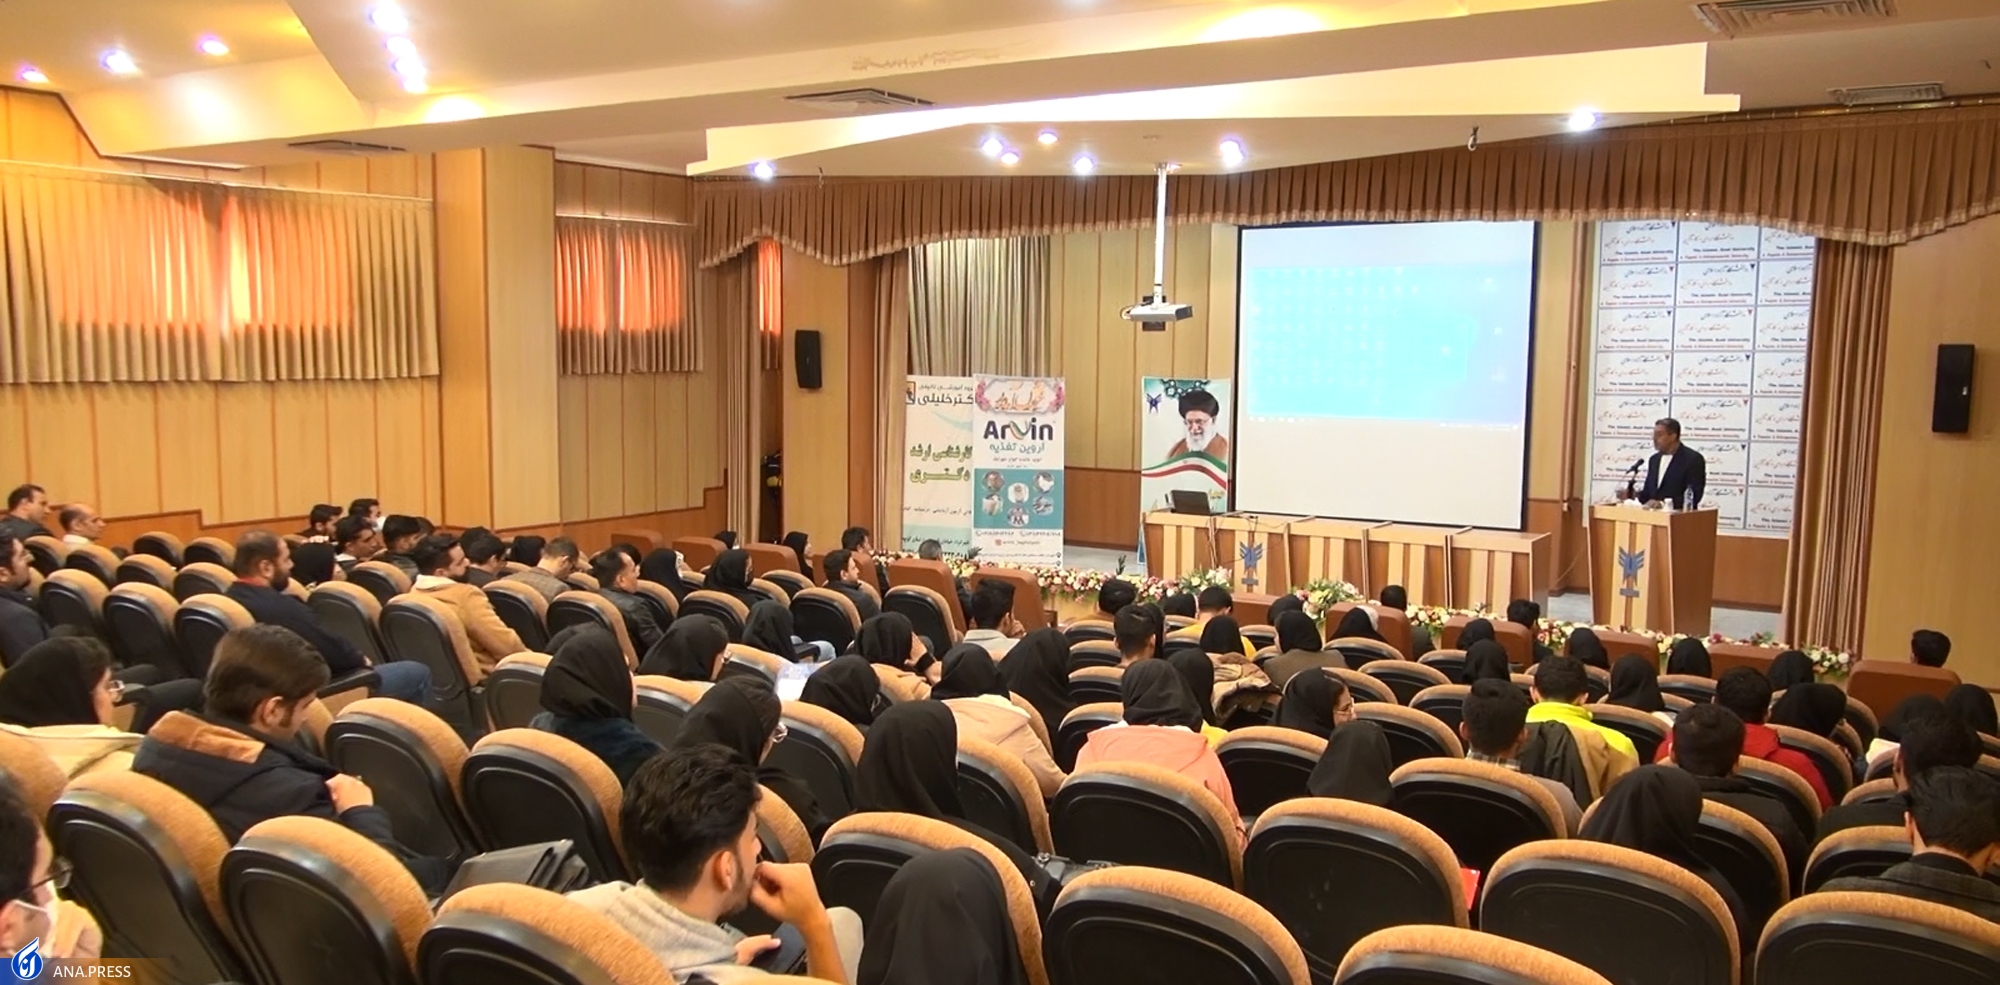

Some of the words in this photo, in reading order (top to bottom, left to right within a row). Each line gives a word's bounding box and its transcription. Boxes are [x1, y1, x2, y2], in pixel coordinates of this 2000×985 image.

[918, 393, 952, 406] خلیلی
[953, 394, 974, 406] کتر
[983, 417, 1054, 440] Arvin
